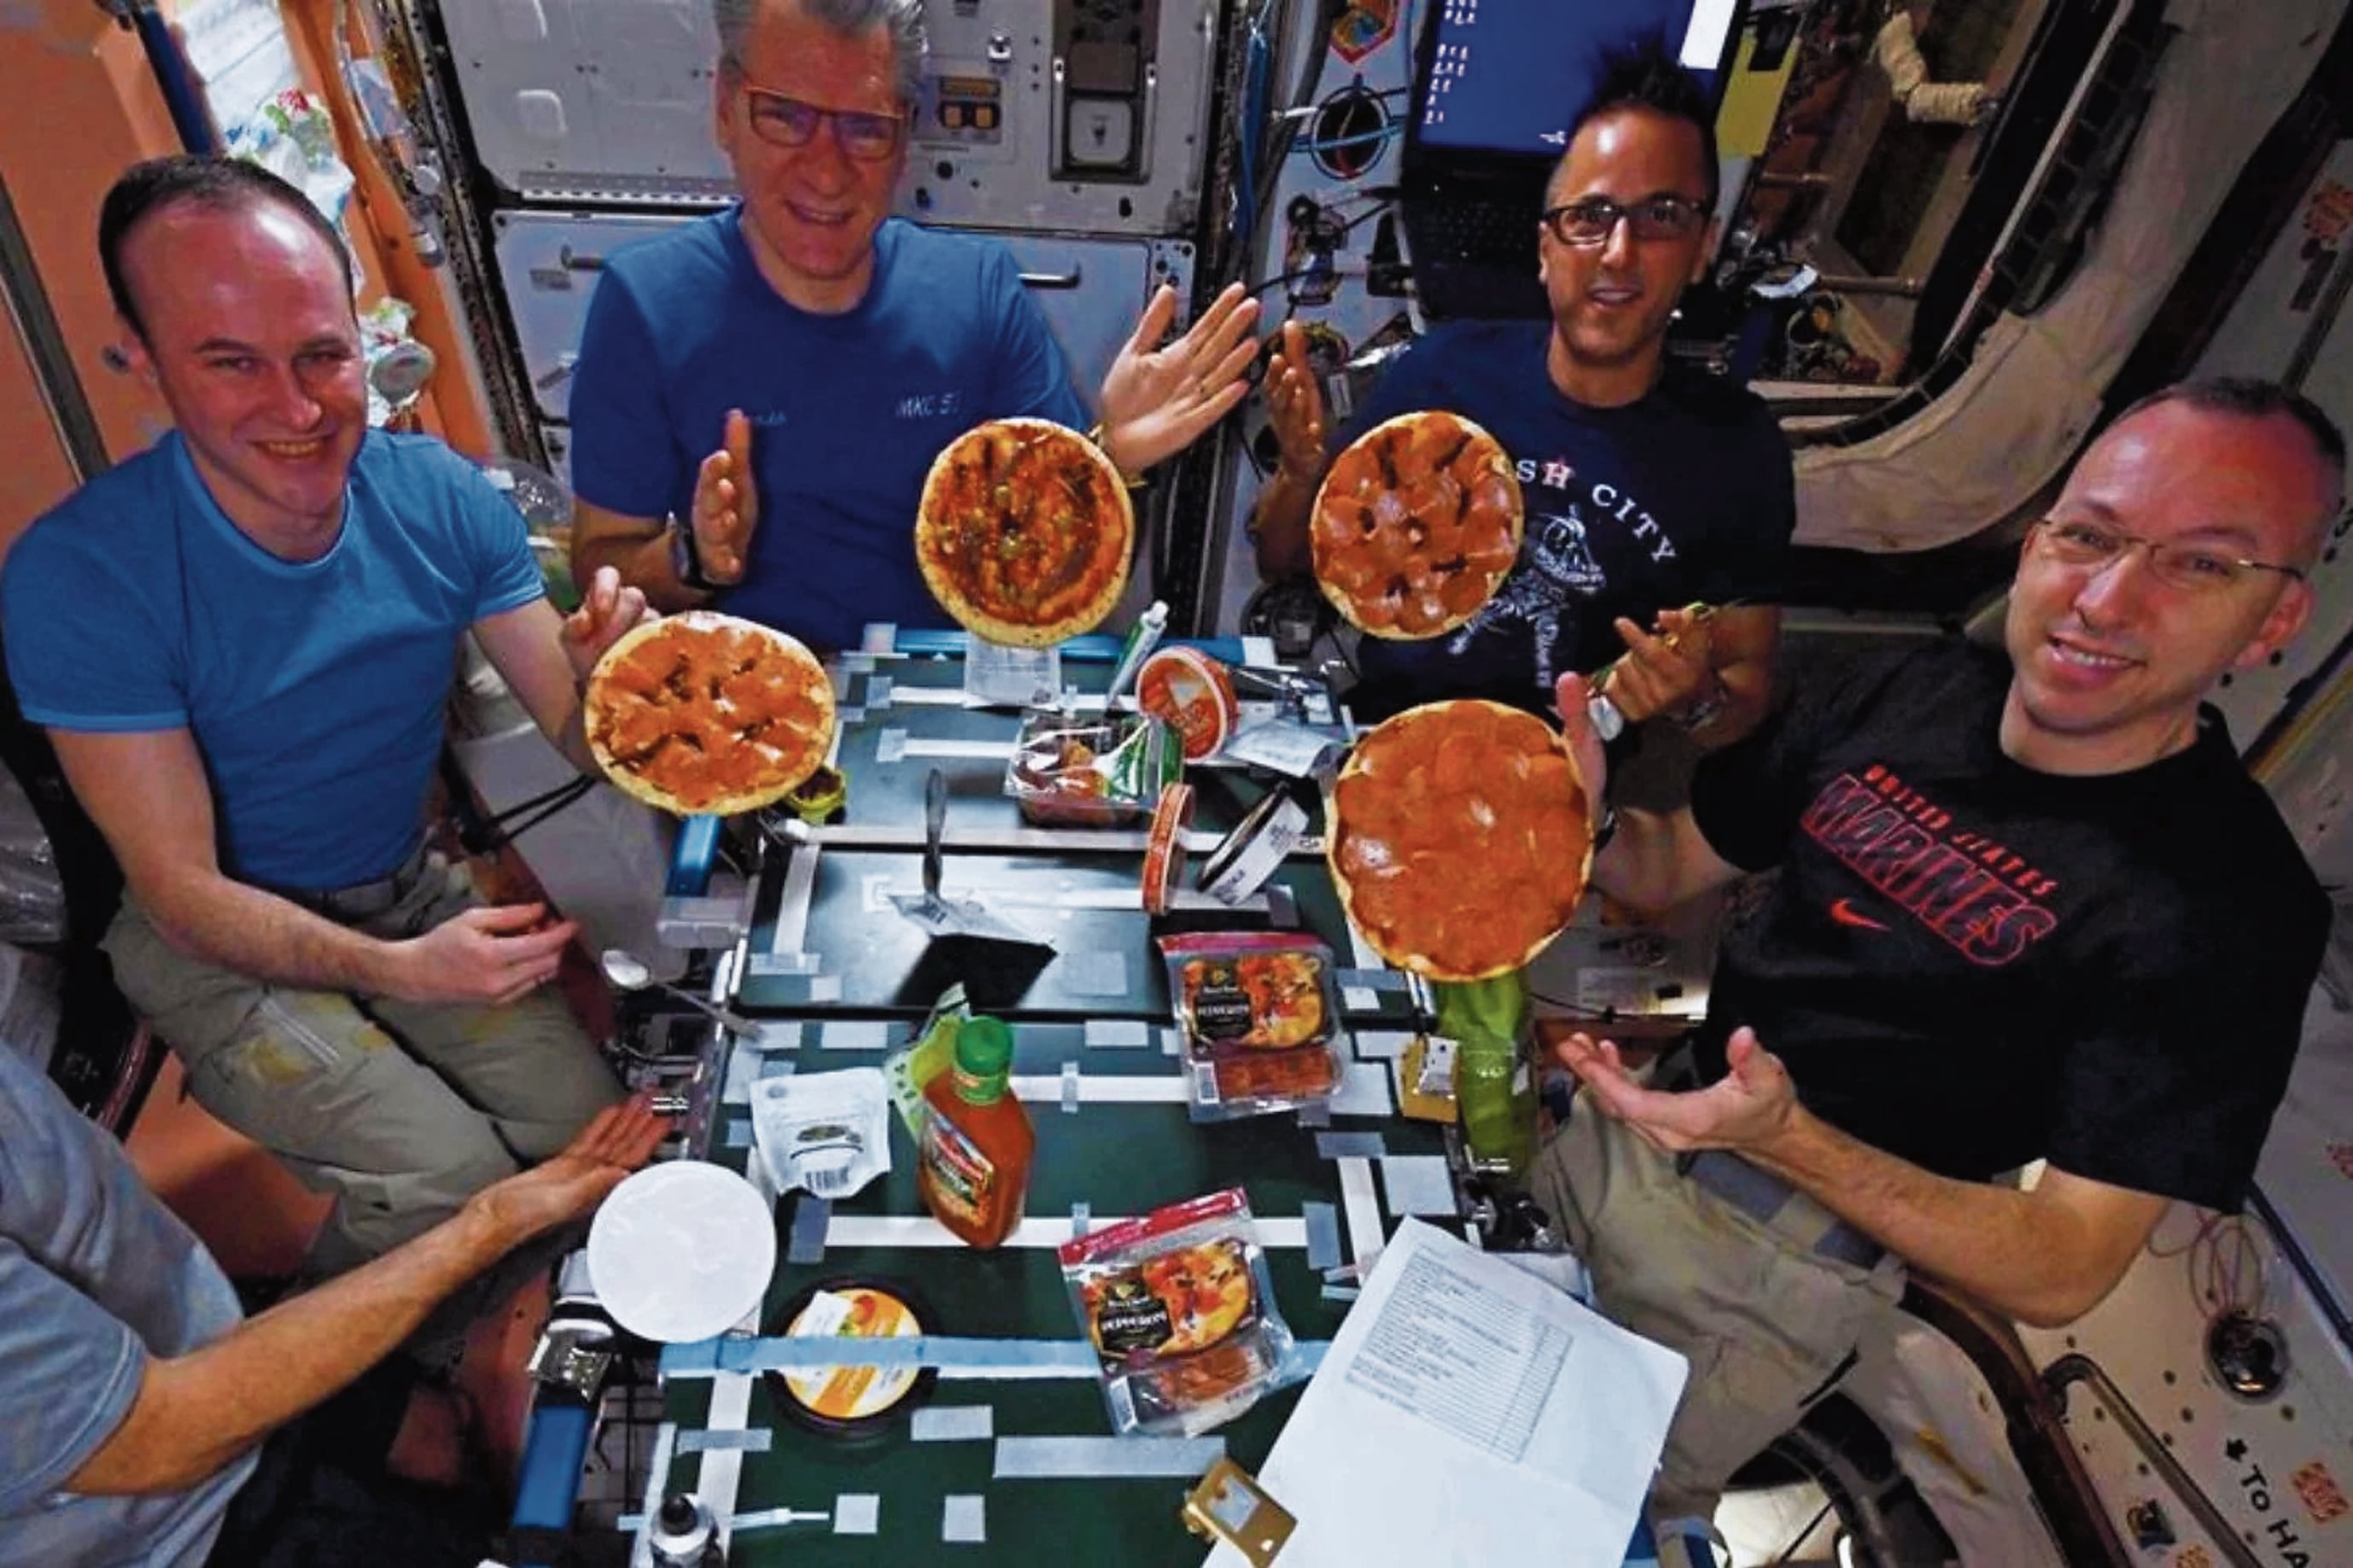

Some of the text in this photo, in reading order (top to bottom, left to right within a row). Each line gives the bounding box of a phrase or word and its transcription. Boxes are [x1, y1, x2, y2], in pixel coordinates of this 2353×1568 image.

[1516, 457, 1676, 562] SH CITY
[1800, 772, 2058, 966] MARINES
[2241, 1465, 2270, 1513] TO
